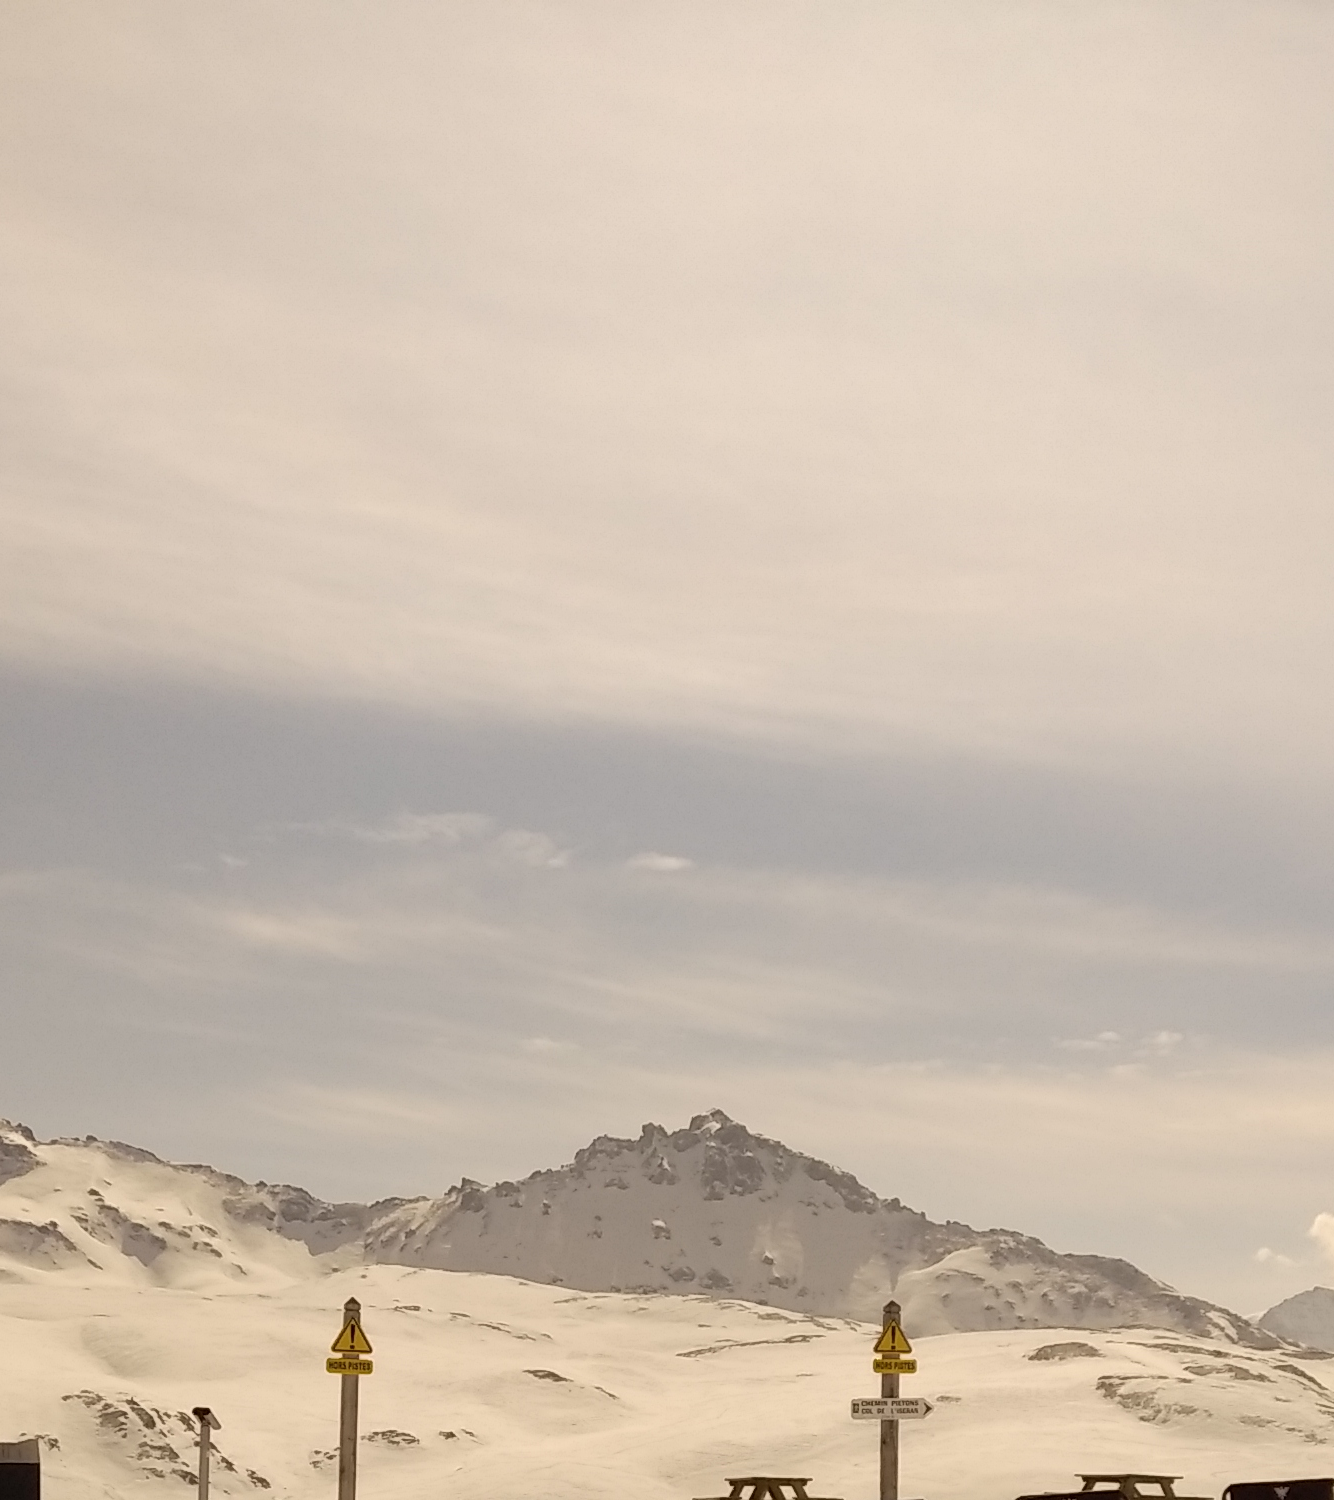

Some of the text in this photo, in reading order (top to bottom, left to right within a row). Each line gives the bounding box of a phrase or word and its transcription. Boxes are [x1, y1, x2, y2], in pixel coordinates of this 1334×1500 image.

[328, 1361, 371, 1371] HORS PISTES
[875, 1361, 915, 1370] HORS PISTES
